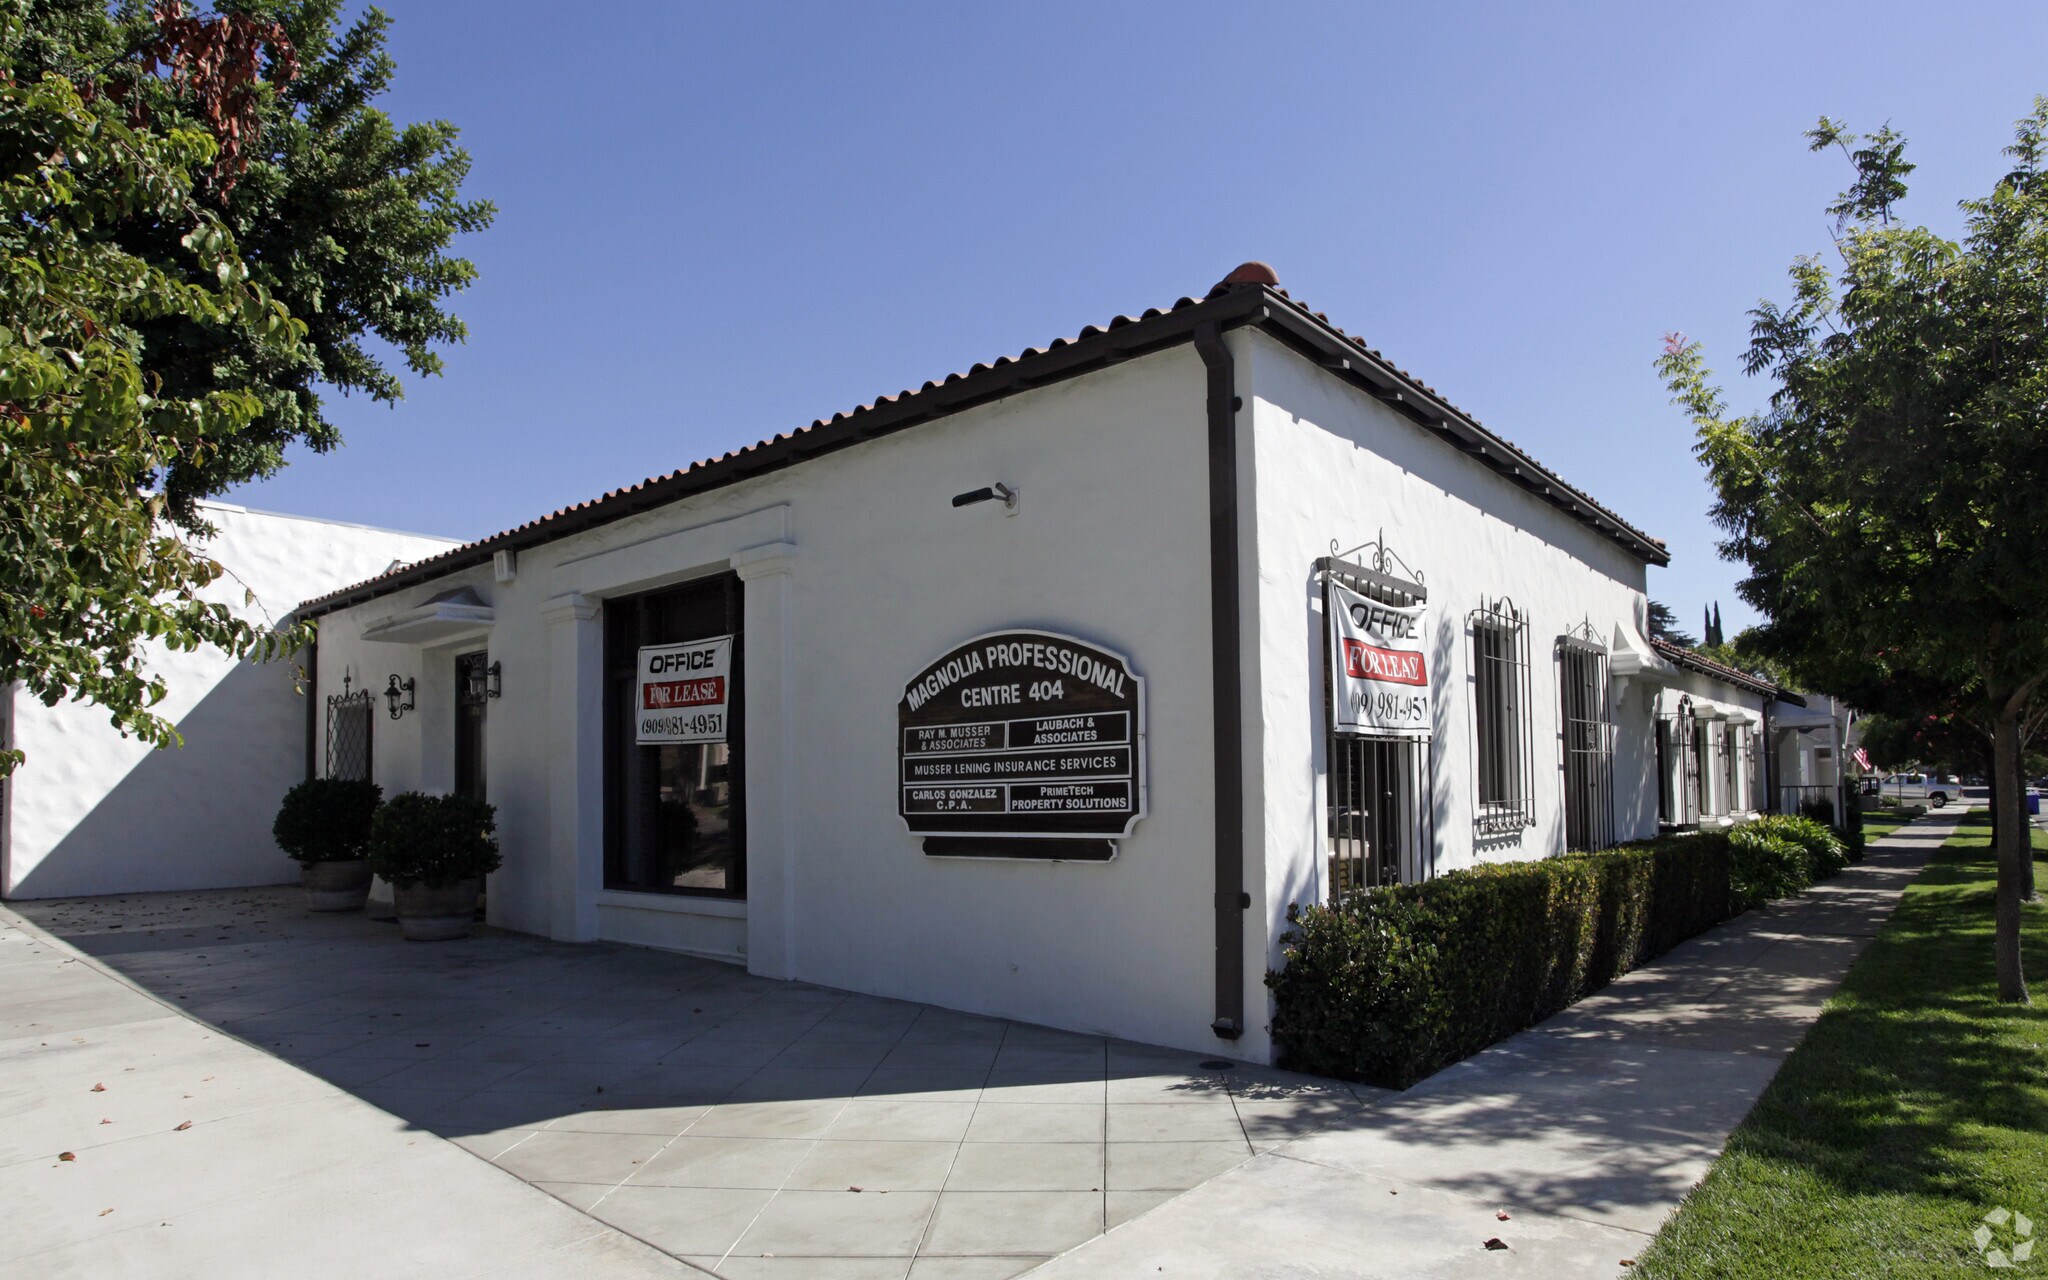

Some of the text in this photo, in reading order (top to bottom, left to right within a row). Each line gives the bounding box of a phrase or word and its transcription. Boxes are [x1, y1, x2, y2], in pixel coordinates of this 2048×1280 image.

[1350, 603, 1418, 639] OFFICE
[650, 649, 716, 674] OFFICE
[1349, 645, 1383, 675] FOR
[906, 642, 1126, 712] MAGNOLIA PROFESSIONAL
[650, 682, 717, 704] FOR LEASE
[961, 680, 1064, 708] CENTRE 404
[918, 726, 991, 740] RAY M. MUSSER
[1036, 717, 1095, 732] LAUBACH &
[921, 738, 986, 751] & ASSOCIATES
[1034, 730, 1097, 744] ASSOCIATES
[914, 756, 1117, 776] MUSSER LENING INSURANCE SERVICES
[912, 788, 997, 801] CARLOS GONZALEZ
[936, 800, 972, 810] C.P.A.
[1012, 797, 1127, 811] PROPERTY SOLUTIONS
